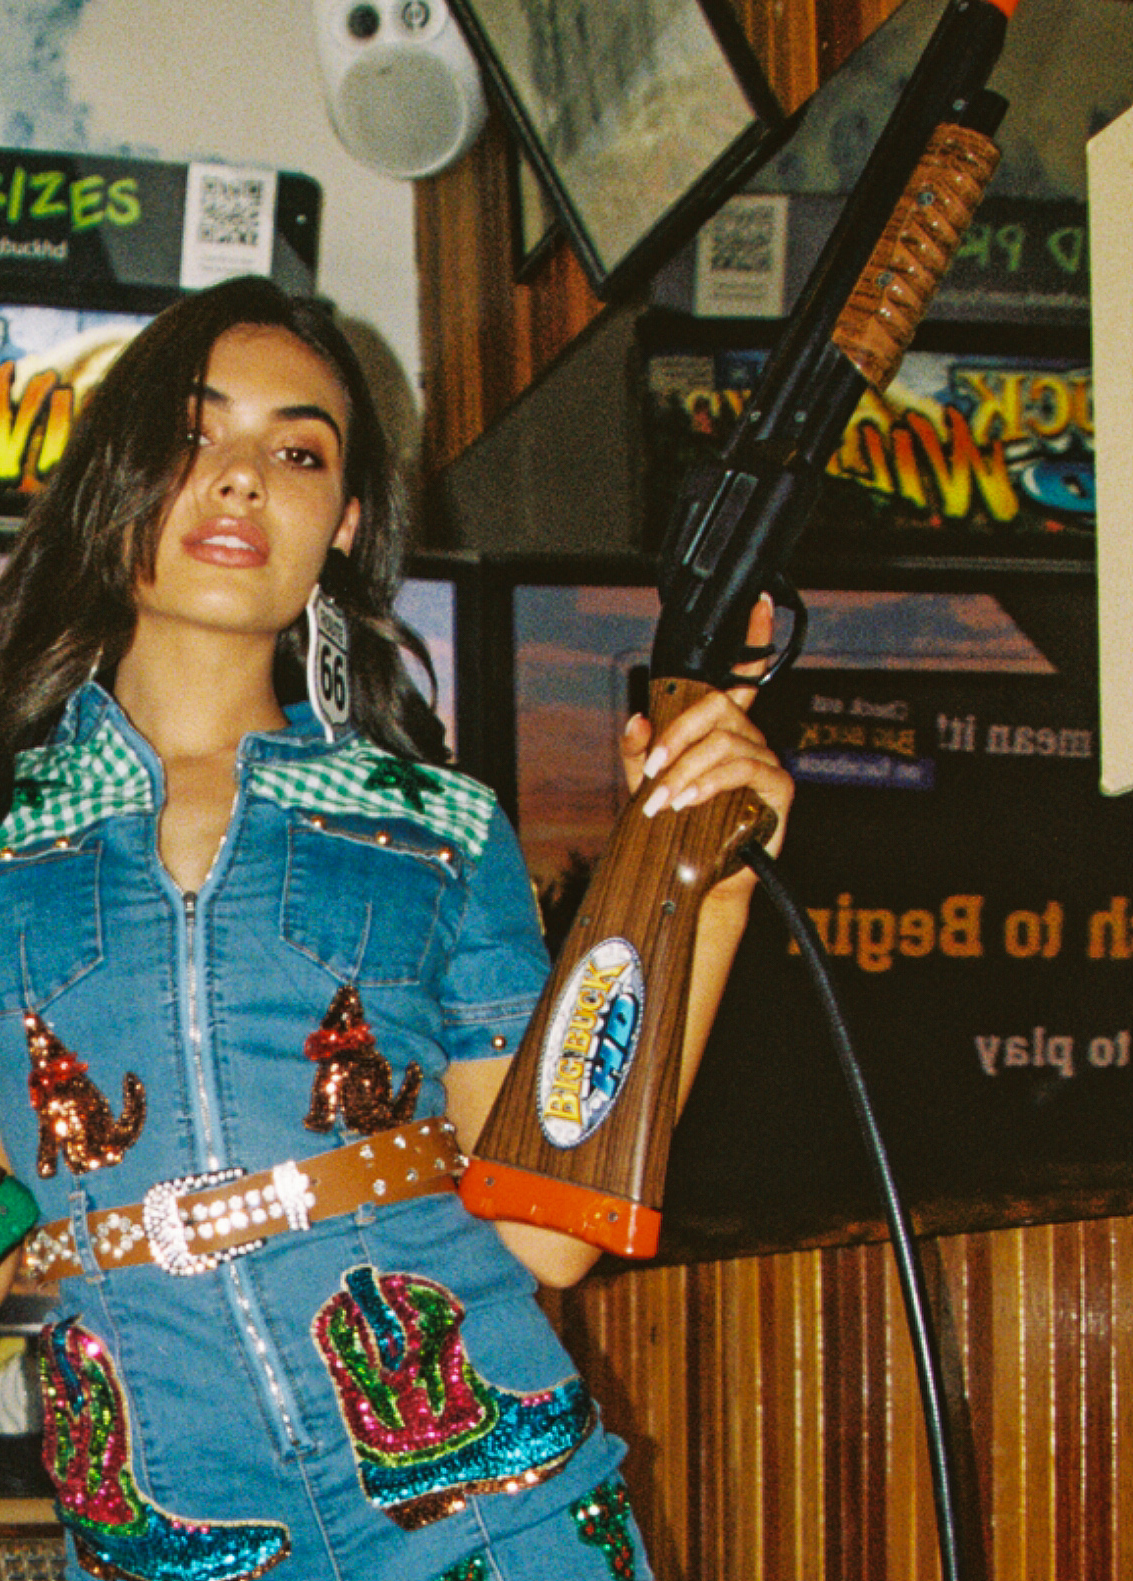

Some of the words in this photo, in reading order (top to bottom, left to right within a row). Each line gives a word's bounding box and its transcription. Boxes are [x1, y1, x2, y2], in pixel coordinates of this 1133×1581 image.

[321, 643, 345, 711] 66
[564, 955, 632, 1061] BUCK
[588, 993, 641, 1096] HD
[543, 1052, 586, 1129] BIG
